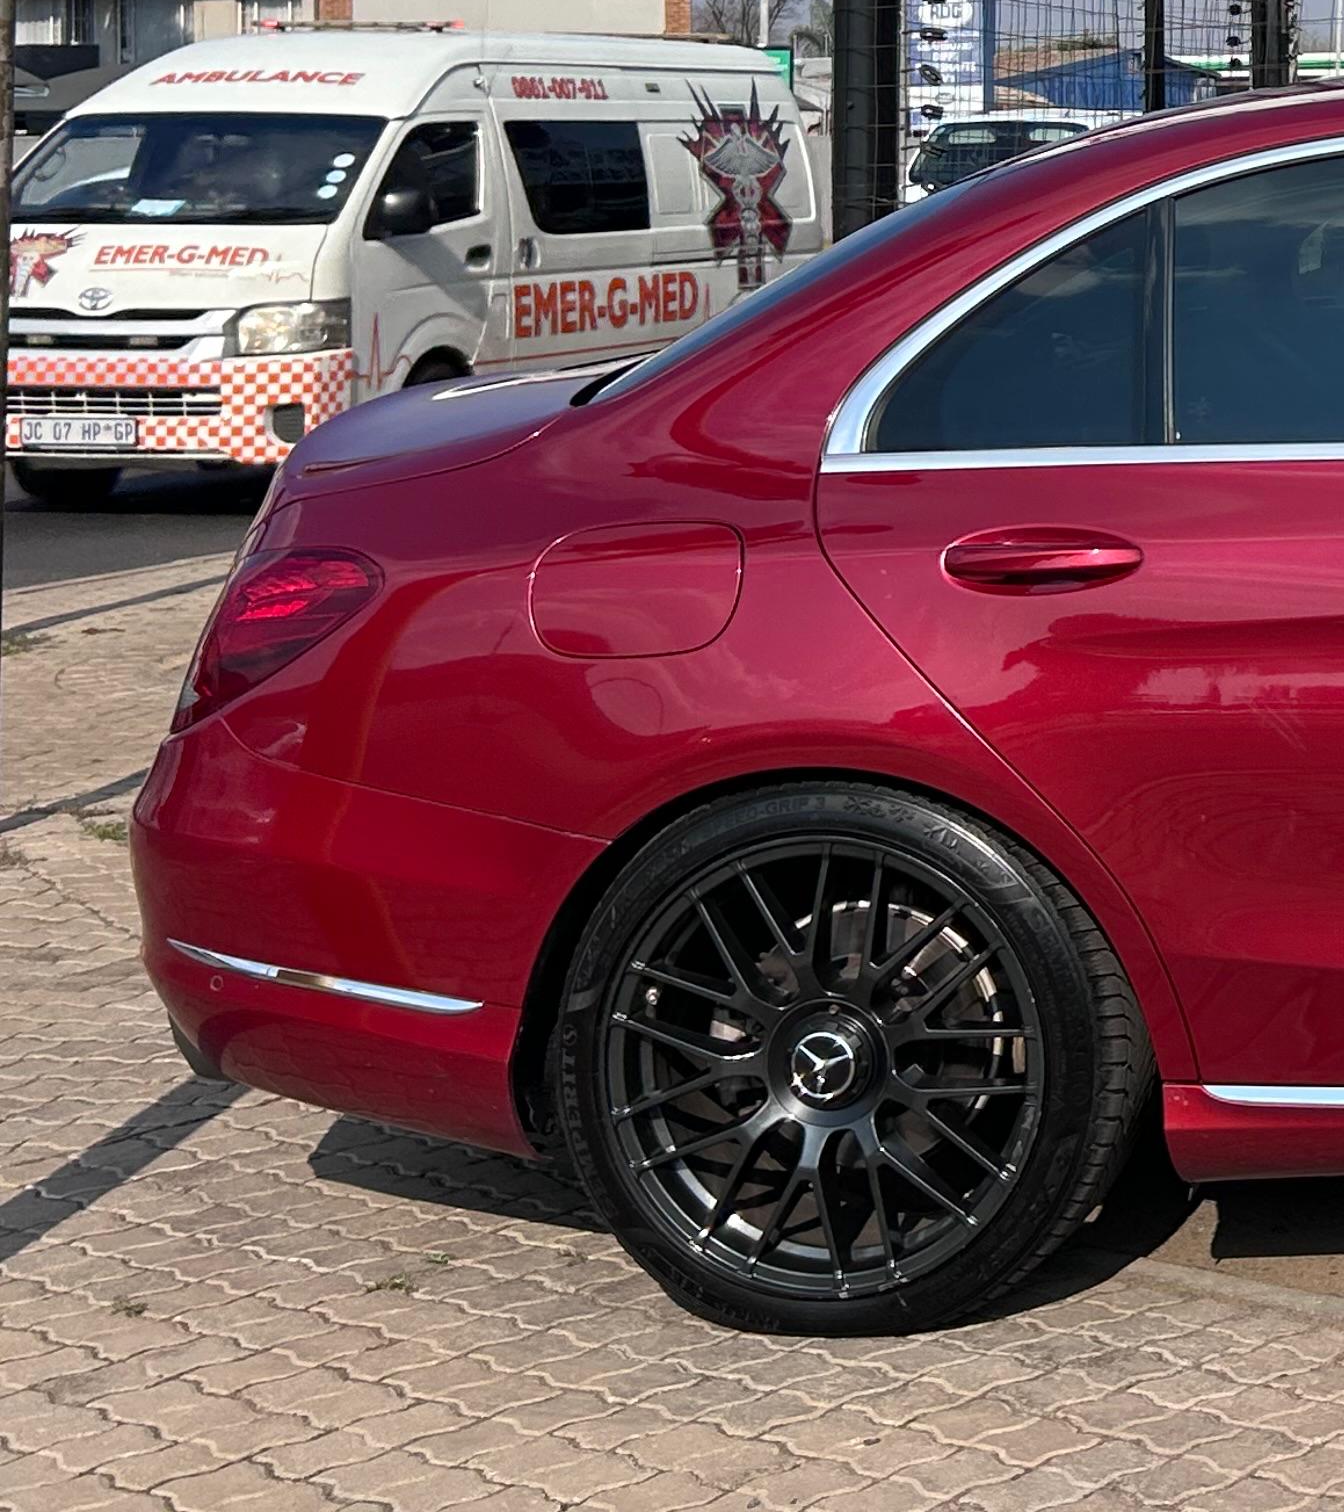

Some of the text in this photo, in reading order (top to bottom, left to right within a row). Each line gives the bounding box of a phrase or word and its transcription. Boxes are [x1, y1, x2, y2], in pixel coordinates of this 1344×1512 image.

[148, 70, 366, 87] AMBULANCE
[94, 244, 270, 266] EMER-G-MED
[514, 271, 700, 339] EMER-G-MED
[24, 421, 134, 441] JC 07 HP GP
